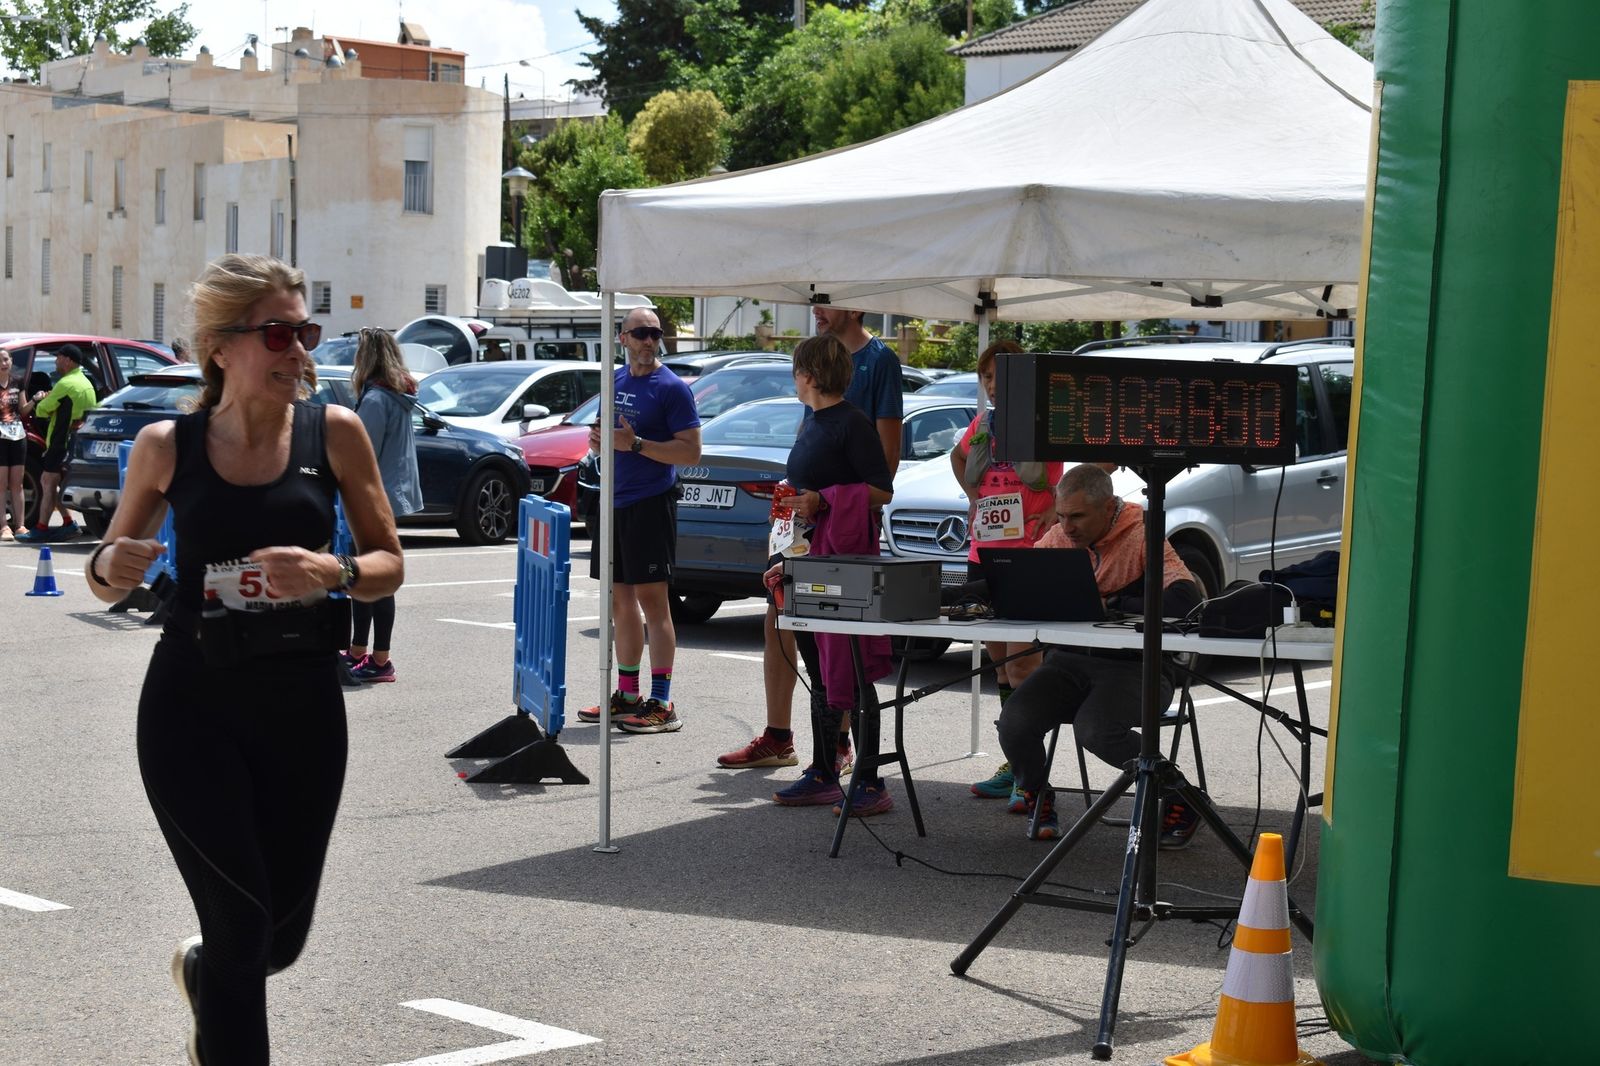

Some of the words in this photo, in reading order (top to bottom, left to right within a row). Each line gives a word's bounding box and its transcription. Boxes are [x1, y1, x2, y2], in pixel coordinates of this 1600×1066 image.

[685, 487, 701, 501] 68
[706, 488, 732, 503] JNT
[981, 509, 1011, 525] 560
